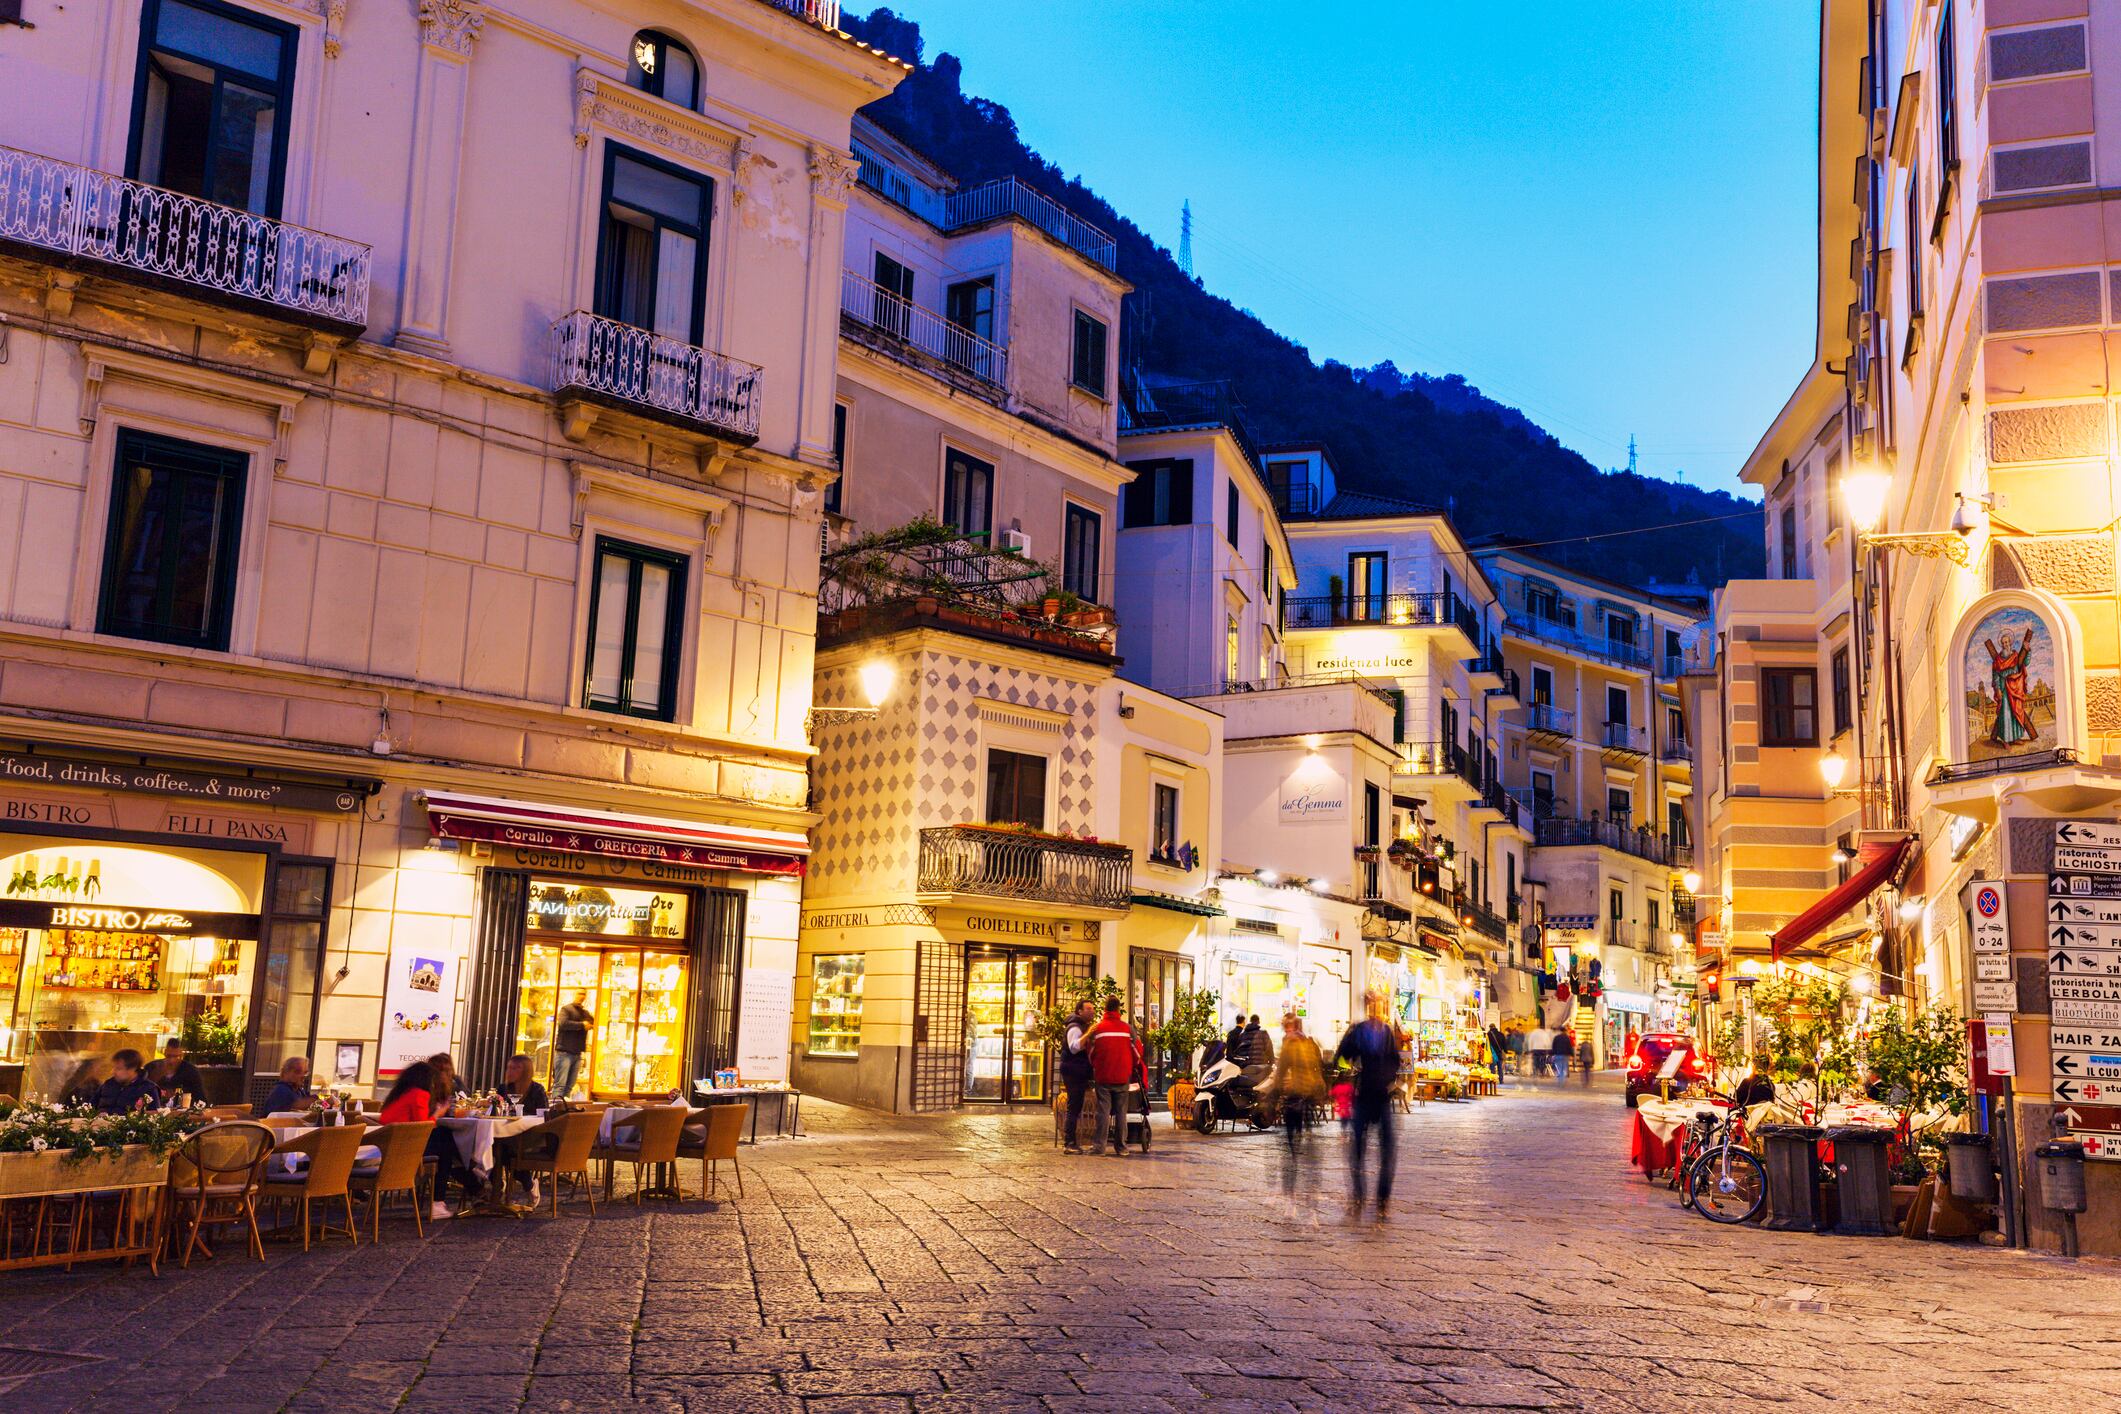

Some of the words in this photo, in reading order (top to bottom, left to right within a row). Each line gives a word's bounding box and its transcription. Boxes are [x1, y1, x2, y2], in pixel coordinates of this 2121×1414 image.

[1317, 655, 1380, 668] residenza
[1385, 655, 1413, 667] luce
[60, 764, 127, 788] drinks,
[1282, 800, 1293, 810] da
[1292, 796, 1342, 815] Gemma
[6, 801, 91, 824] BISTRO
[167, 815, 213, 834] F.LLI
[226, 820, 289, 842] PANSA
[505, 827, 553, 844] Corallo
[594, 838, 668, 857] OREFICERIA
[707, 852, 748, 866] Cammei
[2059, 849, 2108, 859] ristorante
[514, 848, 586, 871] Corallo
[641, 863, 714, 883] Cammei
[2059, 859, 2069, 867] IL
[651, 895, 674, 910] Oro
[50, 907, 140, 929] BISTRO
[810, 913, 869, 928] OREFICERIA
[2100, 912, 2121, 921] L'AN
[967, 916, 1055, 936] GIOIELLERIA
[2111, 939, 2121, 947] F
[1986, 959, 2001, 967] tutta
[1984, 968, 2003, 977] piazza
[2106, 965, 2120, 974] SH
[2051, 978, 2103, 988] erboristeria
[2052, 988, 2120, 999] L'ERBOLA
[2055, 1008, 2119, 1020] Buonvicino
[2054, 1033, 2093, 1046] HAIR
[399, 1054, 431, 1062] TEDORA
[2087, 1067, 2095, 1076] IL
[2099, 1068, 2119, 1077] CUO
[2106, 1147, 2119, 1156] M.
